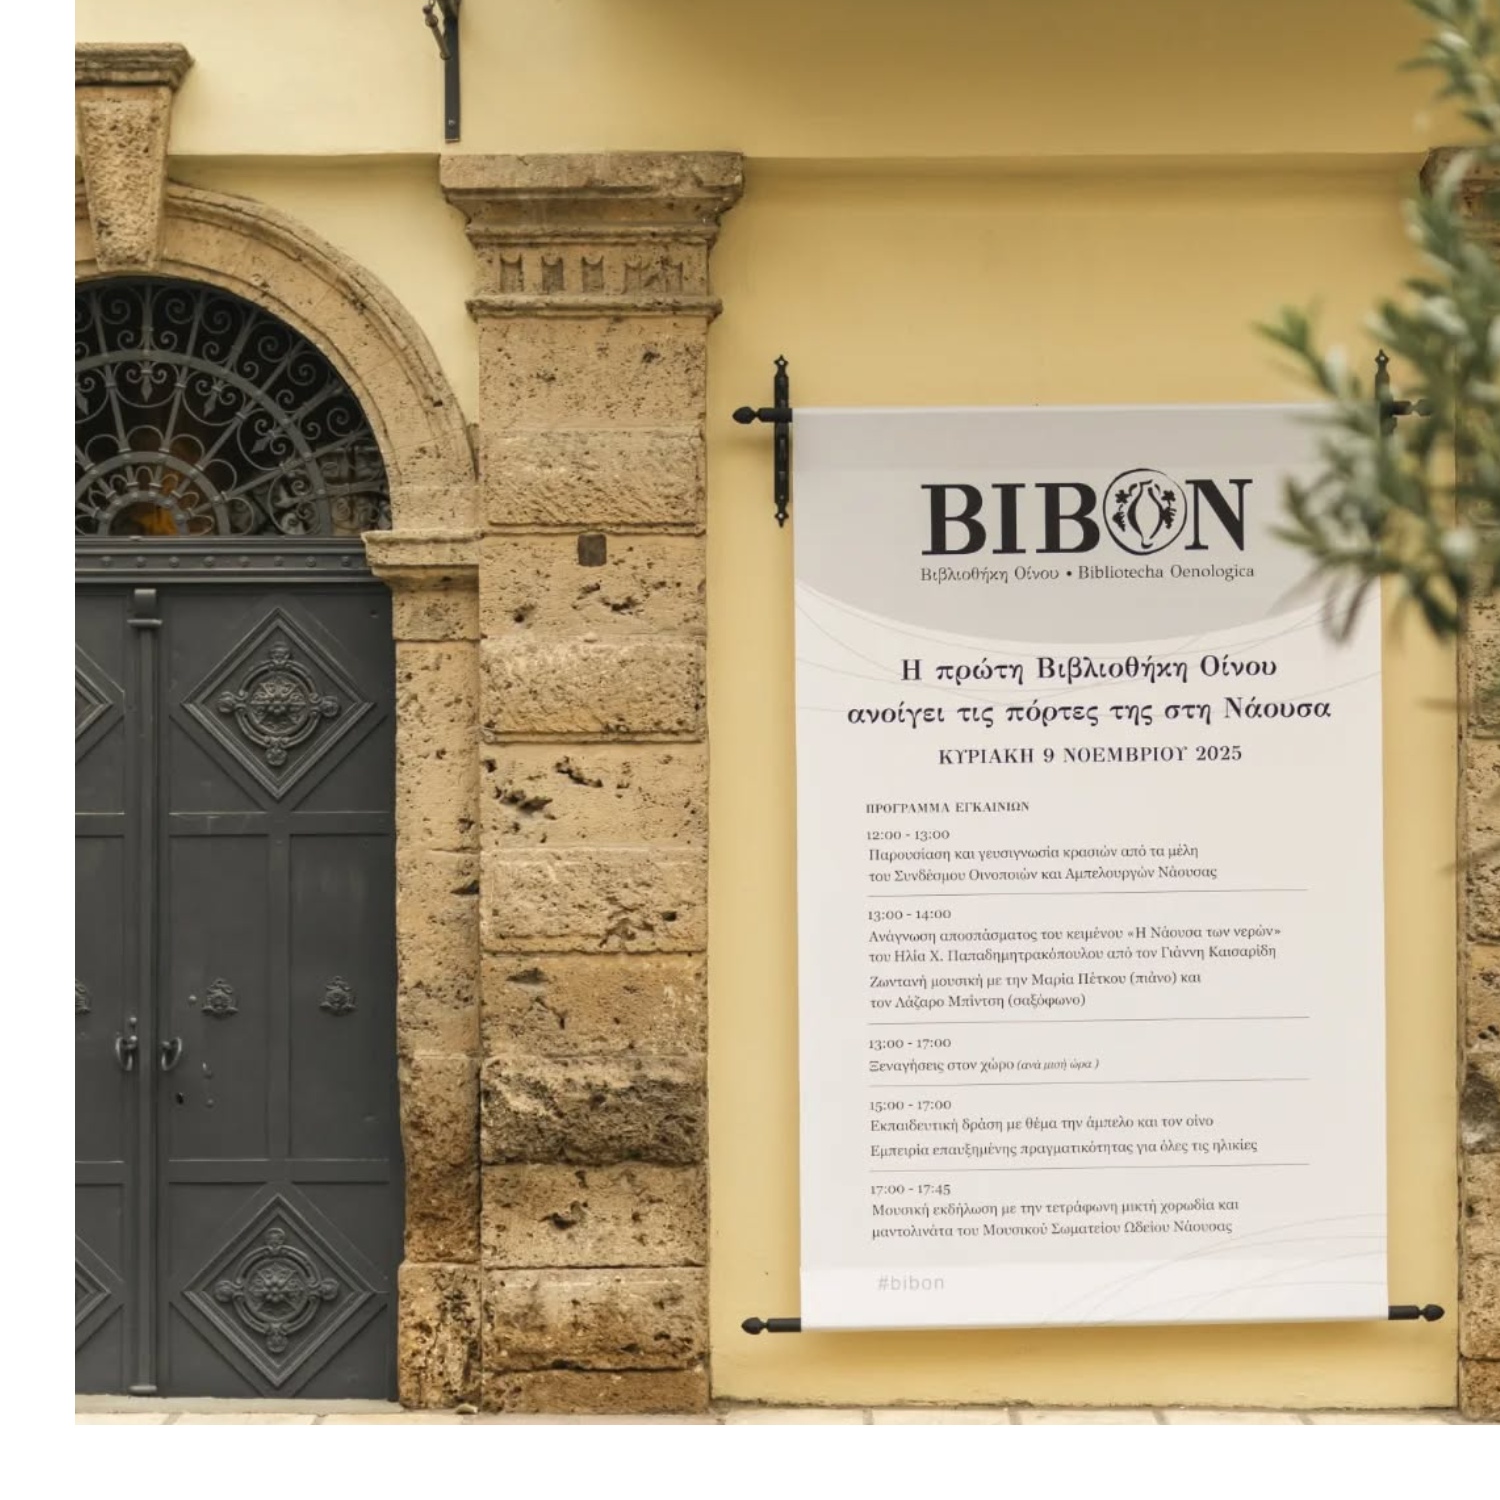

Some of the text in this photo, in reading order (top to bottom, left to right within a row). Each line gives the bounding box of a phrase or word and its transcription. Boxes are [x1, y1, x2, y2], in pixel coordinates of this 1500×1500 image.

[920, 468, 1254, 556] BIBON
[920, 563, 1255, 586] Βιβλιοθήκη Οίνου Bibliotecha Oenologica
[901, 653, 1277, 687] Η πρώτη Βιβλιοθήκη Οίνου
[847, 695, 1331, 731] ανοίγει τις πόρτες της στη Νάουσα
[939, 744, 1242, 766] ΚΥΡΙΑΚΗ 9 ΝΟΕΜΒΡΙΟΥ 2025
[866, 800, 1030, 815] ΠΡΟΓΡΑΜΜΑ ΕΓΚΑΙΝΙΩΝ
[867, 829, 951, 843] 12:00 13:00
[868, 843, 1199, 865] Παρουσίαση και γευσιγνωσία κρασιών από τα μέλη
[867, 864, 1218, 885] του Συνδέσμου Οινοποιών και Αμπελουργών Νάουσας
[867, 909, 952, 924] 13:00 14:00
[868, 929, 936, 947] Ανάγνωση
[938, 926, 1038, 944] αποσπάσματος
[1039, 930, 1063, 941] του
[1065, 925, 1124, 943] κειμένου
[1149, 924, 1203, 939] Νάουσα
[1205, 927, 1231, 939] των
[1232, 923, 1281, 941] νερών»
[867, 953, 891, 964] του
[929, 948, 944, 963] Χ.
[947, 945, 1104, 965] Παπαδημητρακόπουλου
[1106, 945, 1133, 961] από
[1135, 948, 1158, 960] τον
[1160, 944, 1205, 961] Γιάννη
[869, 973, 928, 991] Ζωντανή
[930, 973, 984, 991] μουσική
[986, 976, 1002, 990] με
[1005, 975, 1028, 990] την
[1031, 972, 1075, 989] Μαρία
[1129, 970, 1178, 986] (πιάνο)
[1180, 973, 1202, 984] και
[869, 998, 893, 1009] τον
[894, 994, 945, 1012] Λάζαρο
[1007, 992, 1086, 1010] (σαξόφωνο)
[868, 1037, 952, 1052] 13:00 17:00
[868, 1057, 945, 1075] Ξεναγήσεις
[946, 1061, 978, 1072] στον
[979, 1056, 1015, 1075] χώρο
[870, 1099, 953, 1114] 15:00 17:00
[869, 1113, 1214, 1135] Εκπαιδευτική δράση με θέμα την άμπελο και τον οίνο
[869, 1137, 1258, 1161] Εμπειρία επαυξημένης πραγματικότητας για όλες τις ηλικίες
[870, 1182, 951, 1196] 17:00 17:45
[872, 1201, 930, 1220] Μουσική
[932, 1201, 998, 1219] εκδήλωση
[1001, 1204, 1017, 1218] με
[1019, 1203, 1043, 1218] την
[1044, 1199, 1119, 1217] τετράφωνη
[1121, 1198, 1157, 1216] μικτή
[1217, 1200, 1239, 1212] και
[956, 1226, 979, 1237] του
[982, 1221, 1049, 1237] Μουσικού
[1051, 1219, 1121, 1238] Σωματείου
[1123, 1219, 1170, 1234] Ωδείου
[1173, 1218, 1233, 1235] Νάουσας
[877, 1274, 945, 1292] #bibon
